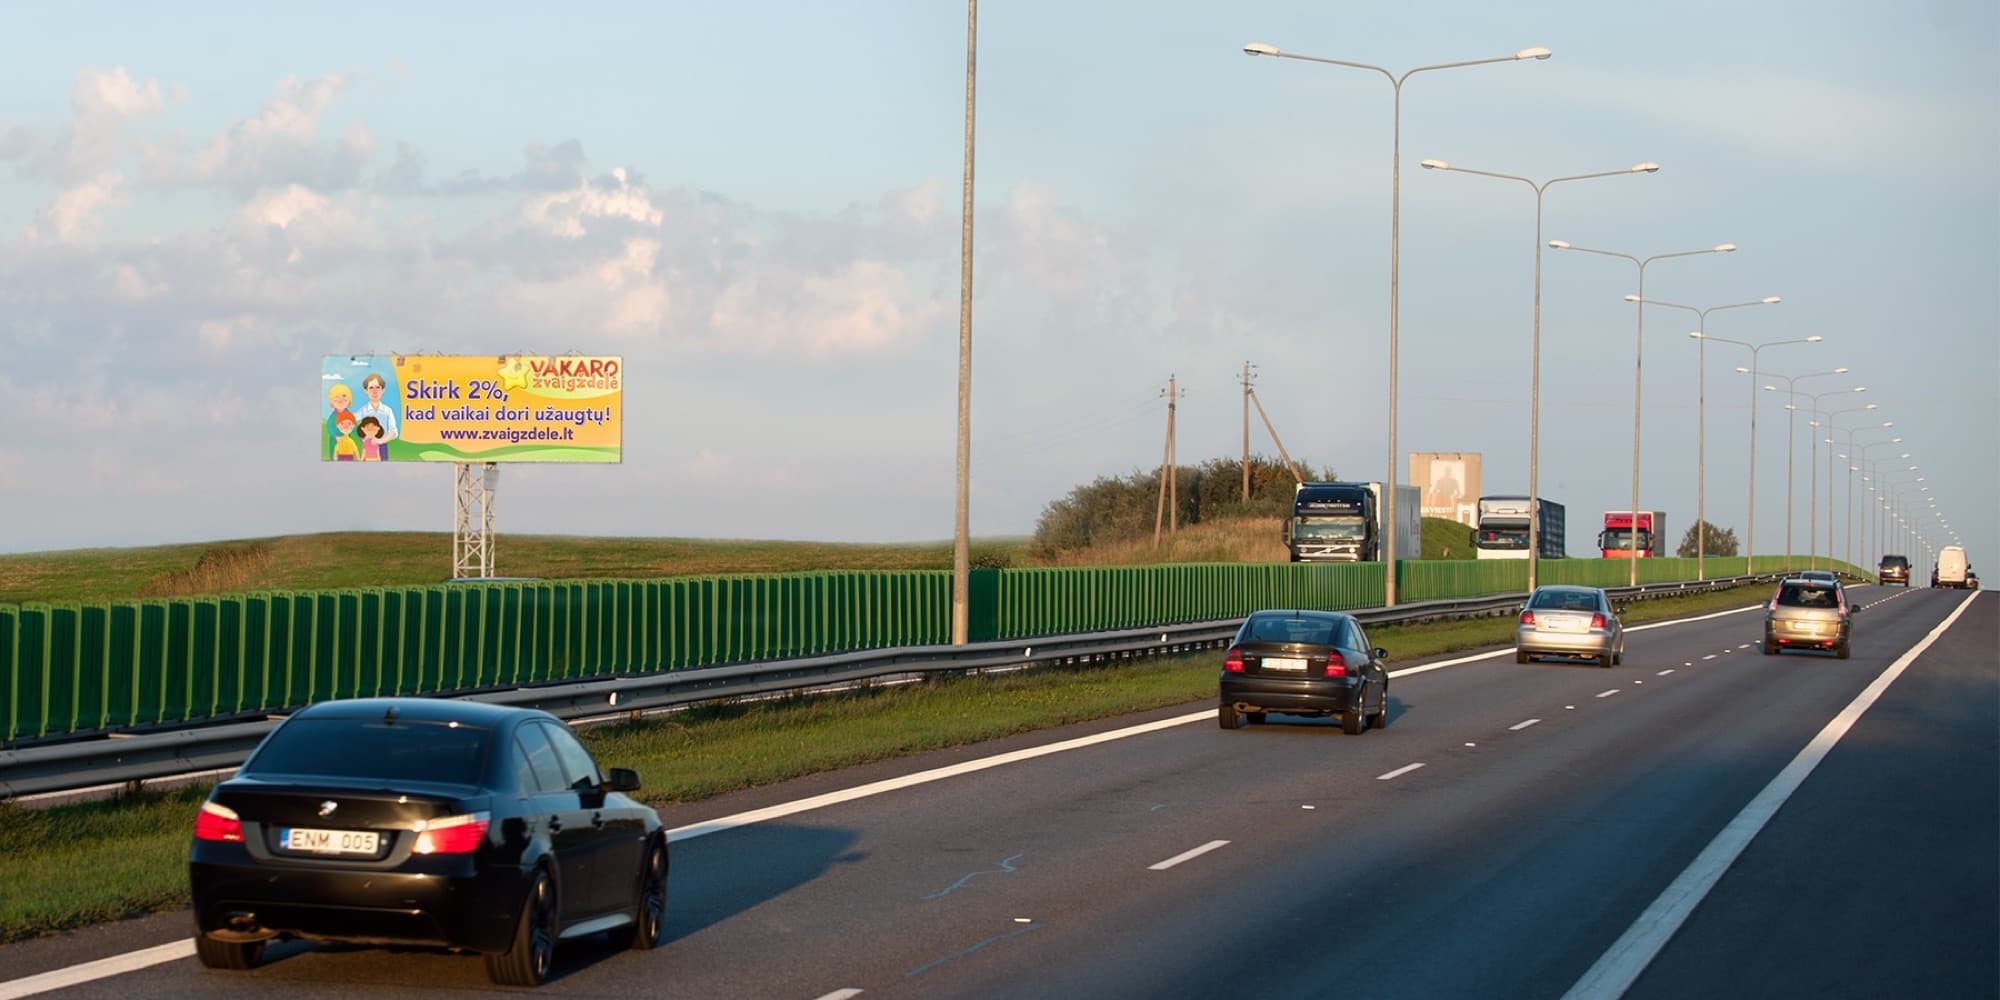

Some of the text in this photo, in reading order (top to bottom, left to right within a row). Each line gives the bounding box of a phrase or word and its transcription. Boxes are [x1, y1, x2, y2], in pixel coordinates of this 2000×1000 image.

[530, 360, 618, 376] VAKARO
[406, 380, 509, 401] Skirk 2%,
[405, 405, 610, 425] kad vaikai dori užaugtų!
[440, 427, 573, 442] www.zvaigzdele.lt
[291, 830, 373, 851] ENM 005
